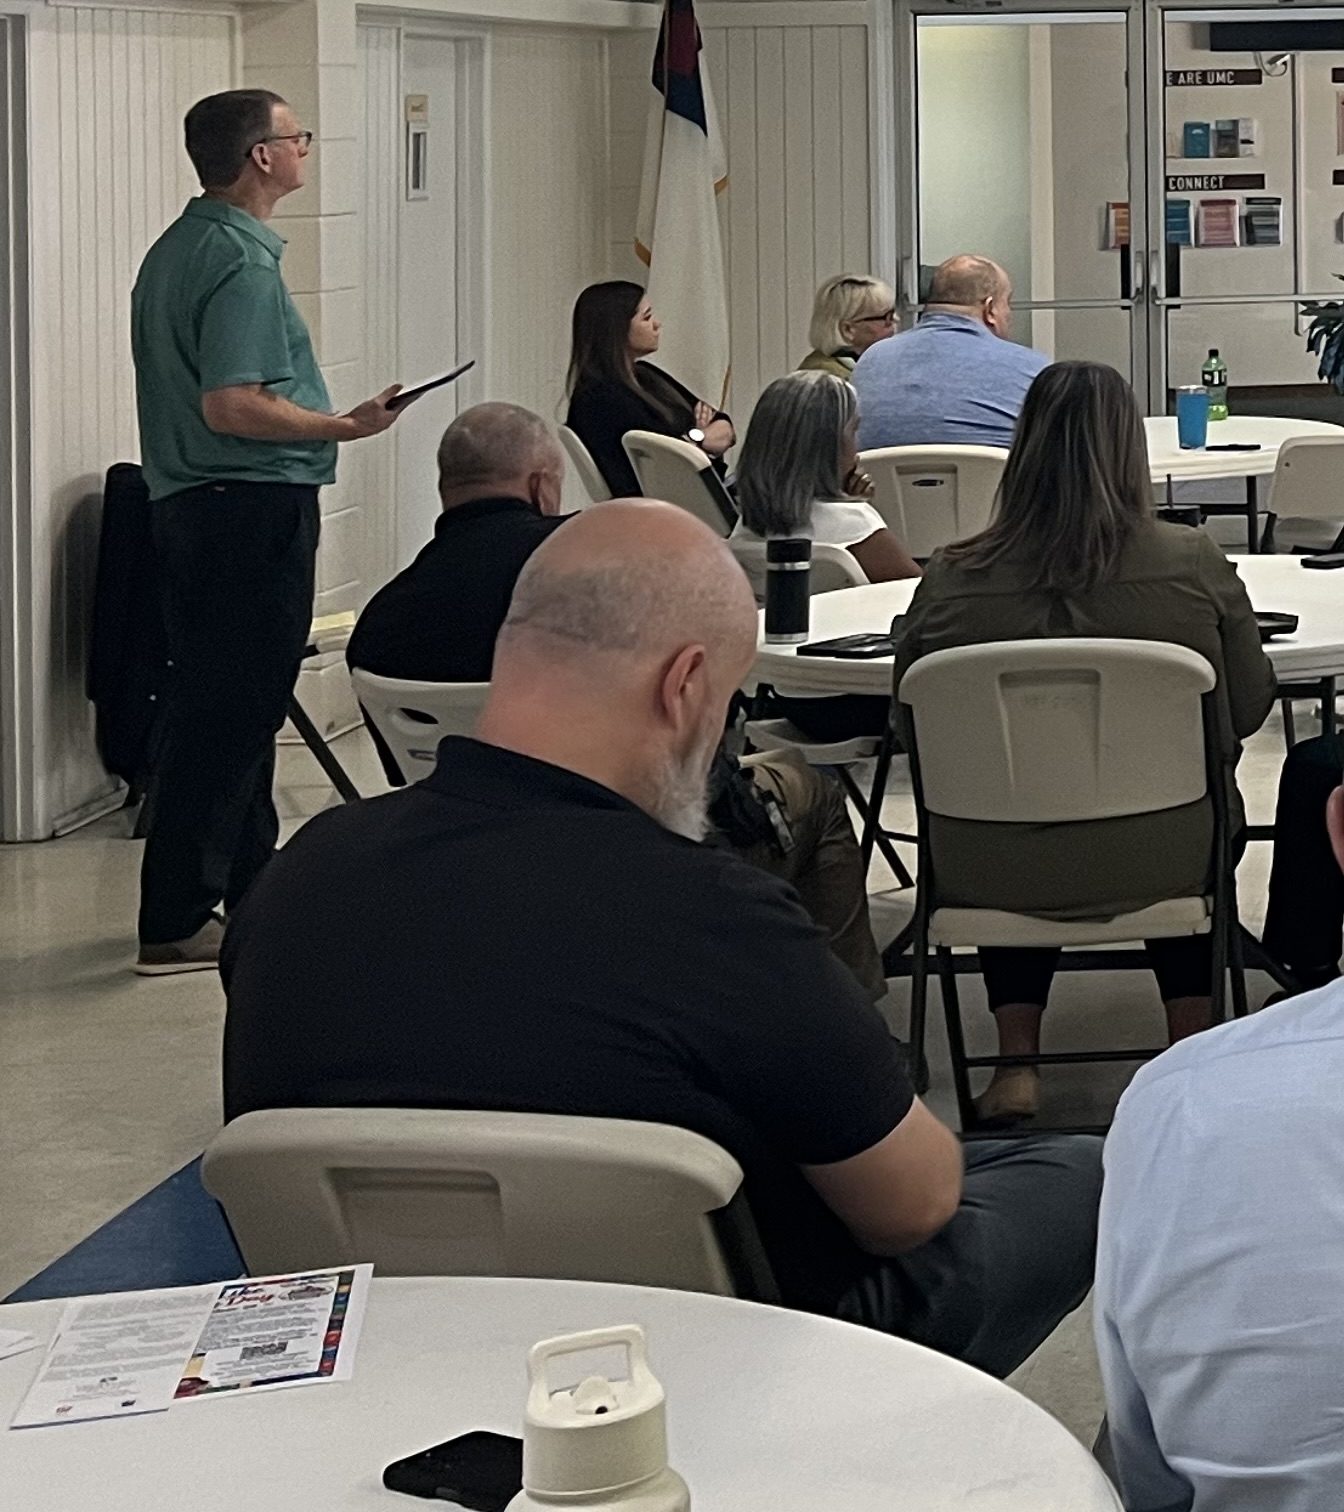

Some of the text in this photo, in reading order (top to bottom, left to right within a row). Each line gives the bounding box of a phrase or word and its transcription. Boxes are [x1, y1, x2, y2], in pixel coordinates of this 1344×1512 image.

[1178, 72, 1203, 85] ARE
[1207, 71, 1235, 84] UMC
[1168, 176, 1225, 190] CONNECT
